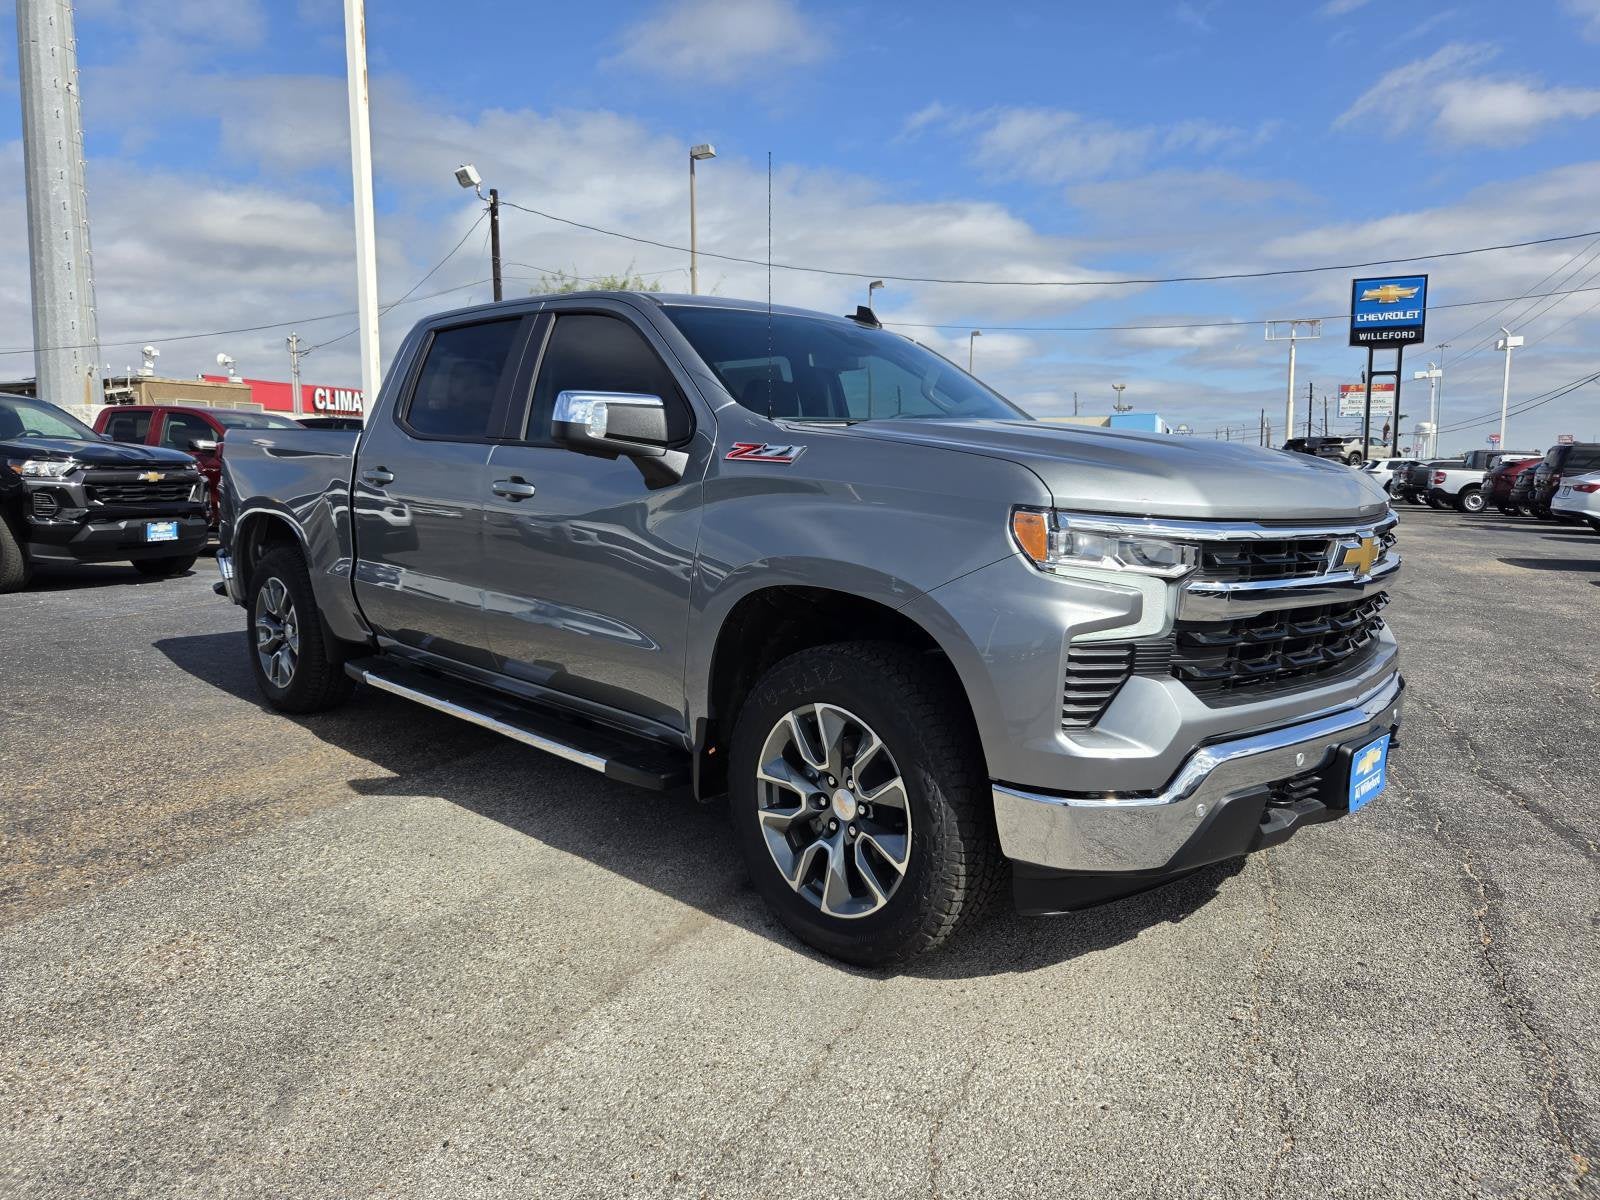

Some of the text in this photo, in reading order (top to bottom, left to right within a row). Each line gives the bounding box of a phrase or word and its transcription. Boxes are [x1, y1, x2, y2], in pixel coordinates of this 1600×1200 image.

[1357, 310, 1420, 322] CHEVROLET
[1359, 331, 1416, 340] WILLEFORD
[314, 387, 364, 412] CLIMA
[723, 442, 807, 464] Z71
